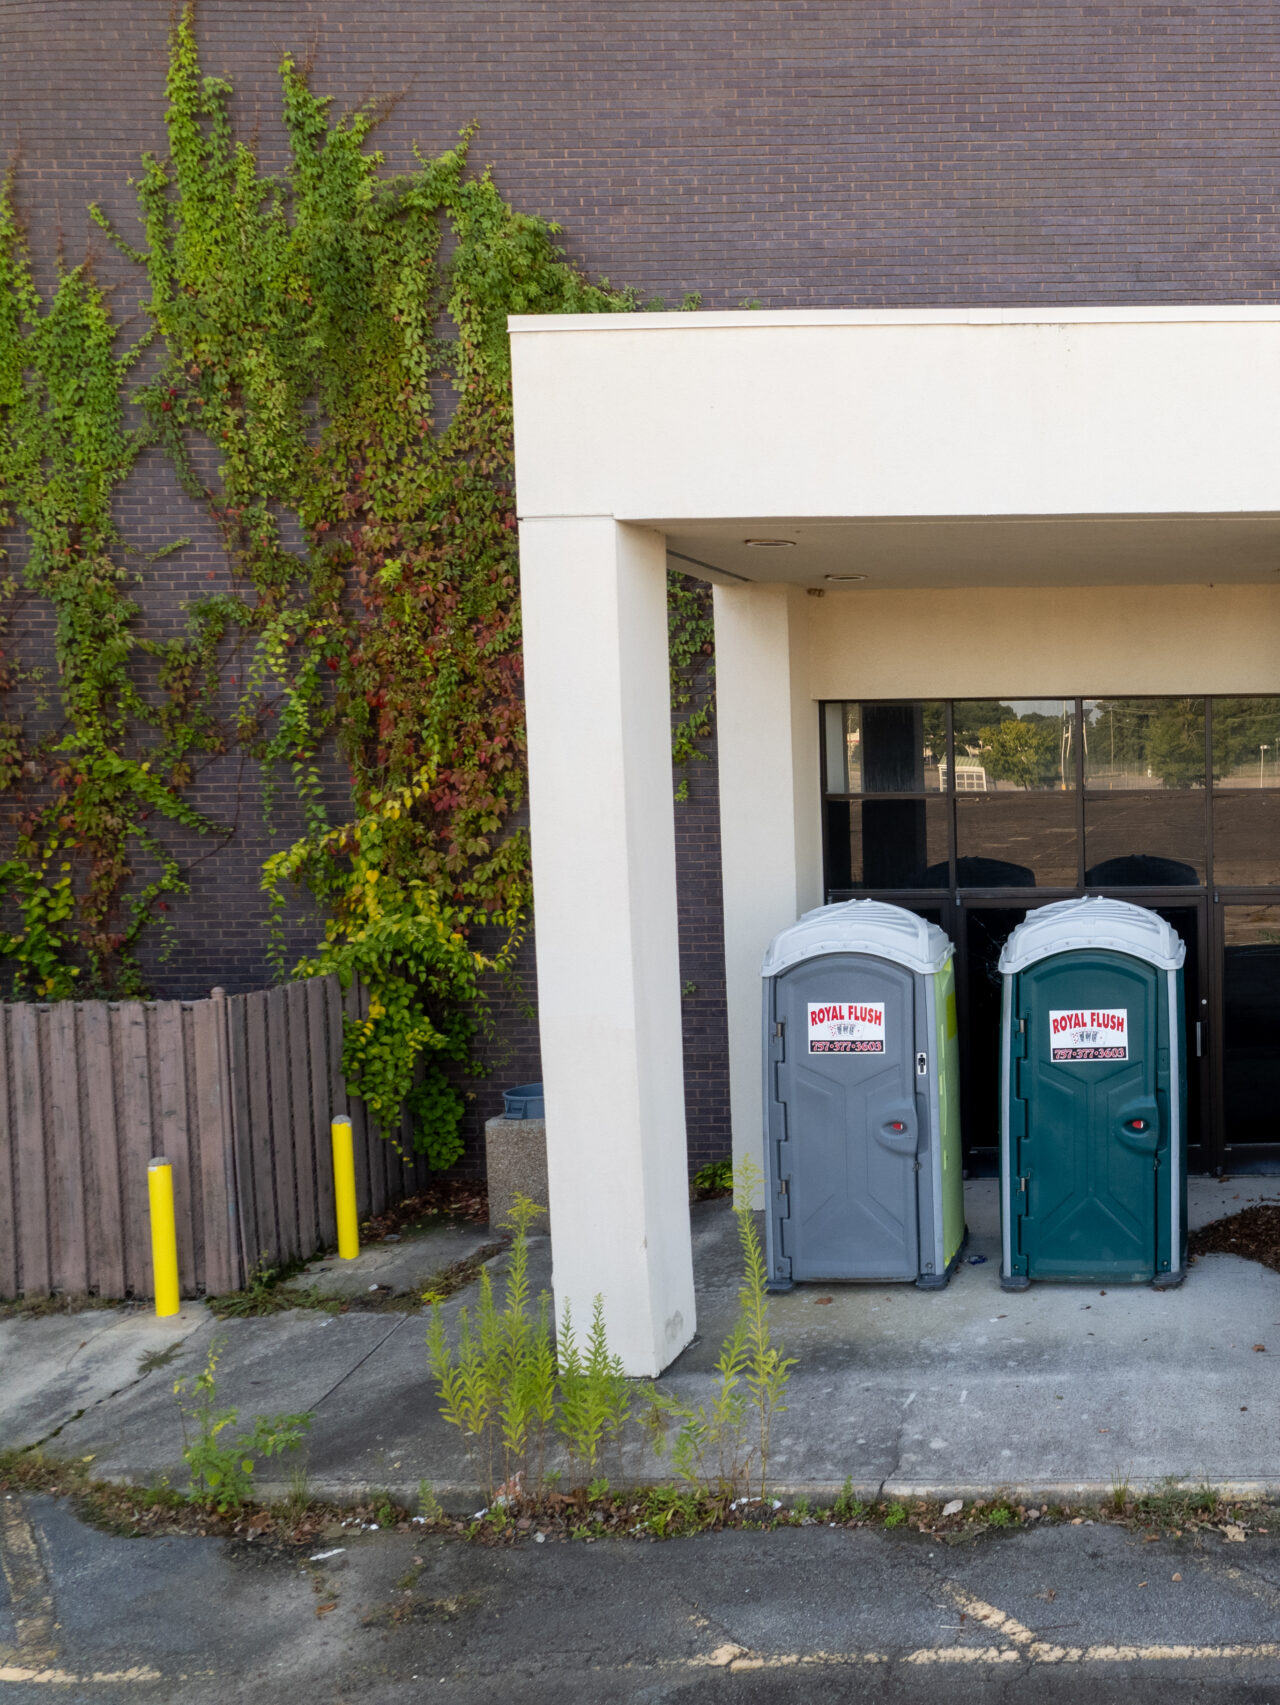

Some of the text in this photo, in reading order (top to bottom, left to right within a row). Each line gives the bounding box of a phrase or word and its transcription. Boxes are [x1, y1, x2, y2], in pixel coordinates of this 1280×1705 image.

[810, 1005, 882, 1026] ROYAL FLUSH
[1052, 1012, 1124, 1034] ROYAL FLUSH
